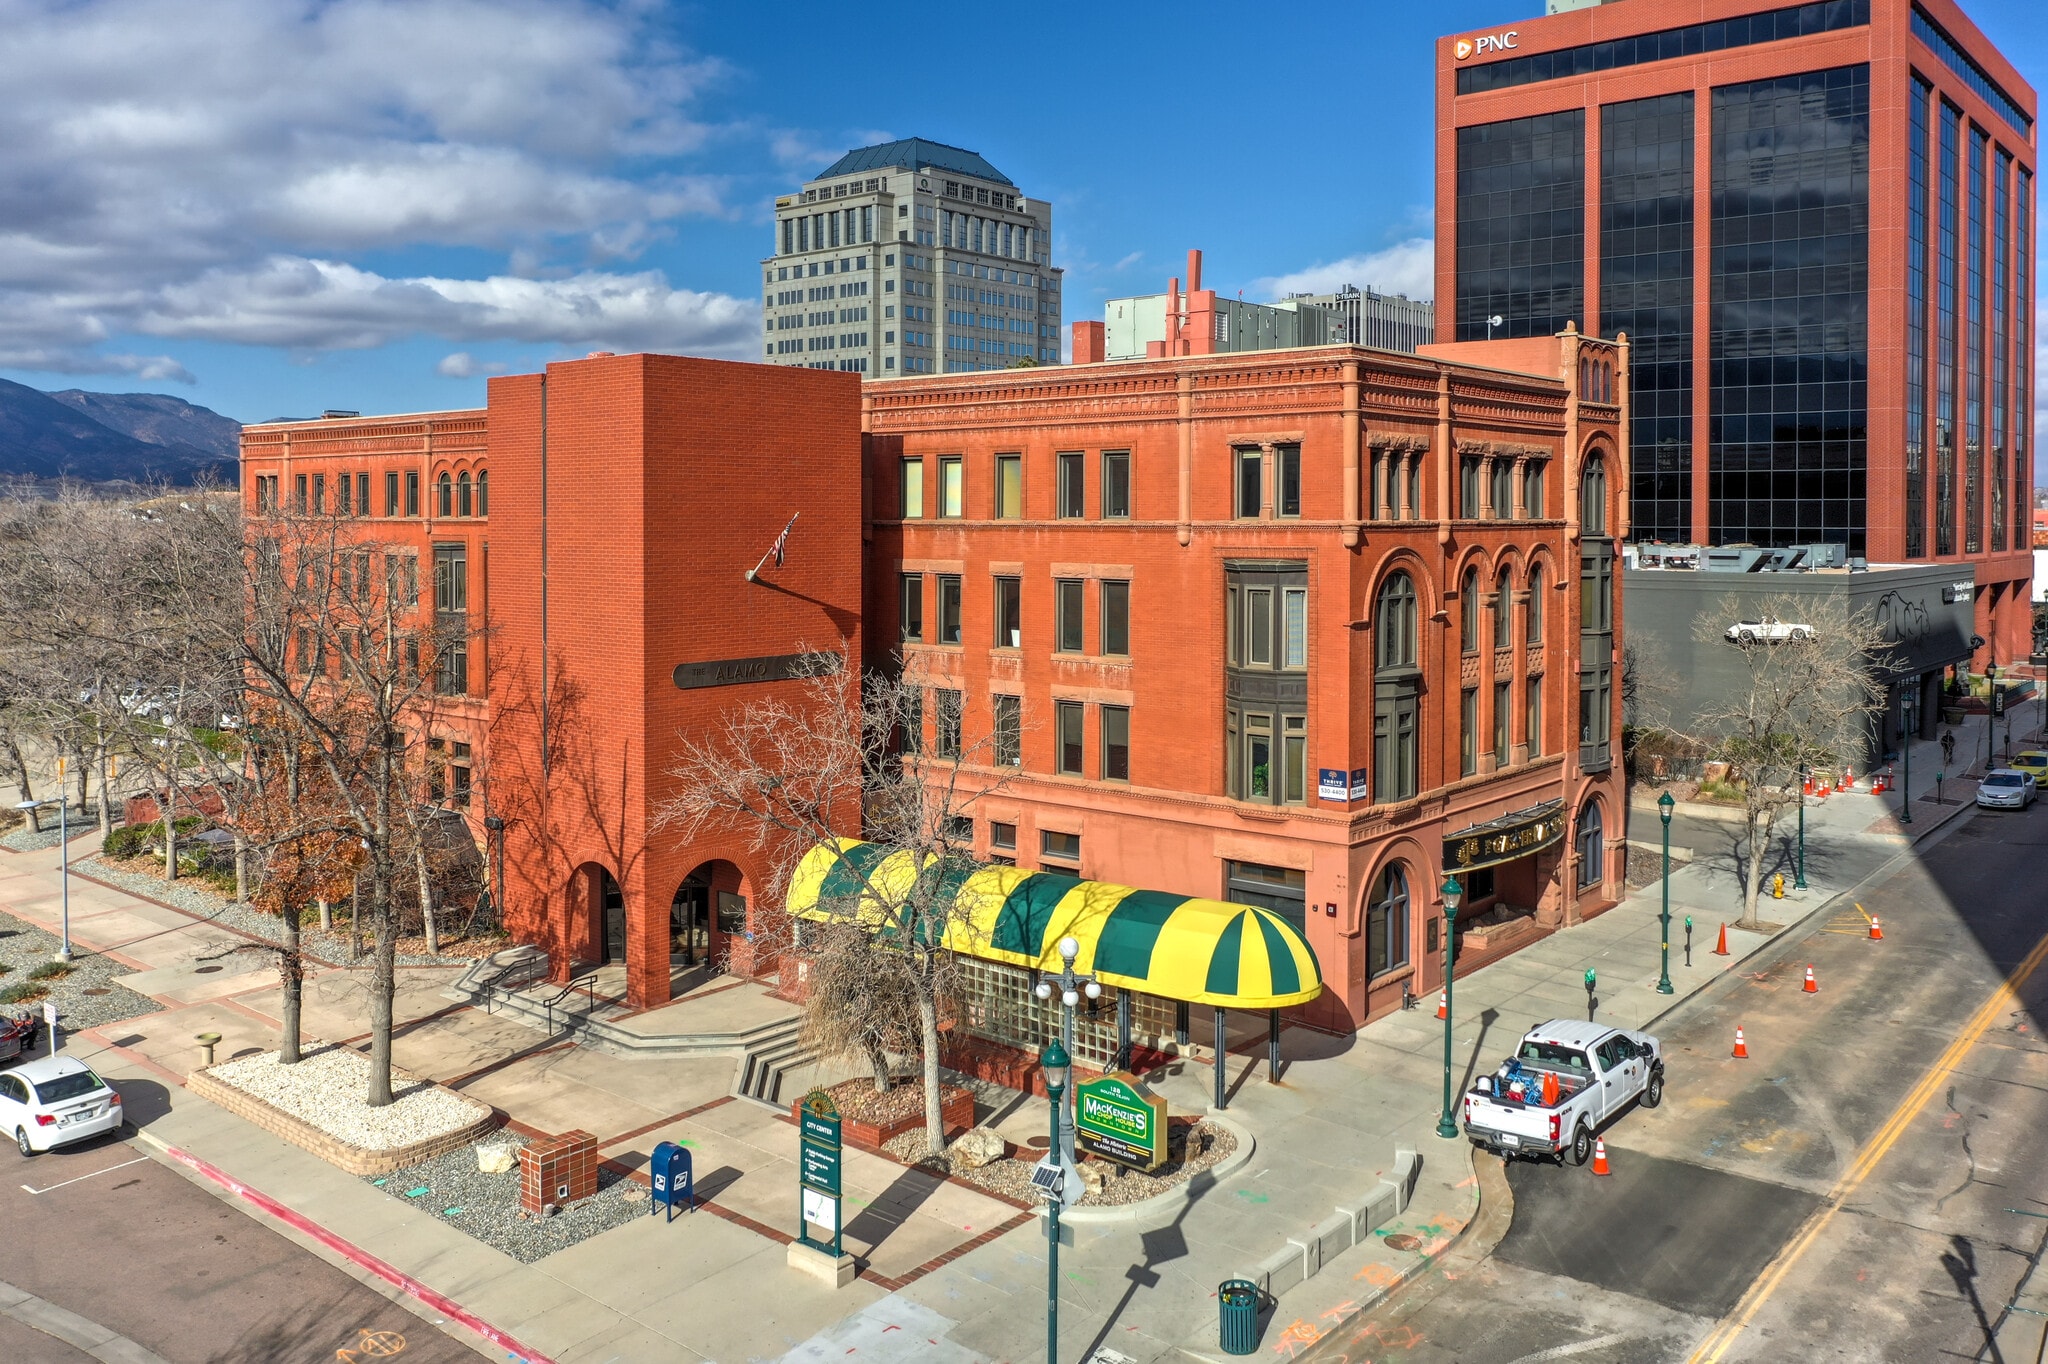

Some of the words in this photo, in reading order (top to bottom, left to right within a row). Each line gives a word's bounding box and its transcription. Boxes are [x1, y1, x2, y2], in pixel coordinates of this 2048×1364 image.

[1475, 31, 1518, 54] PNC
[692, 668, 706, 677] THE
[716, 662, 767, 681] ALAMO
[1100, 1088, 1115, 1096] SOUTH
[1110, 1086, 1121, 1094] 128
[1097, 1111, 1113, 1120] CHOP
[1115, 1117, 1136, 1128] HOUSE
[806, 1121, 816, 1130] CITY
[816, 1124, 833, 1136] CENTER
[1093, 1141, 1111, 1151] ALAMO
[1111, 1147, 1137, 1160] BUILDING
